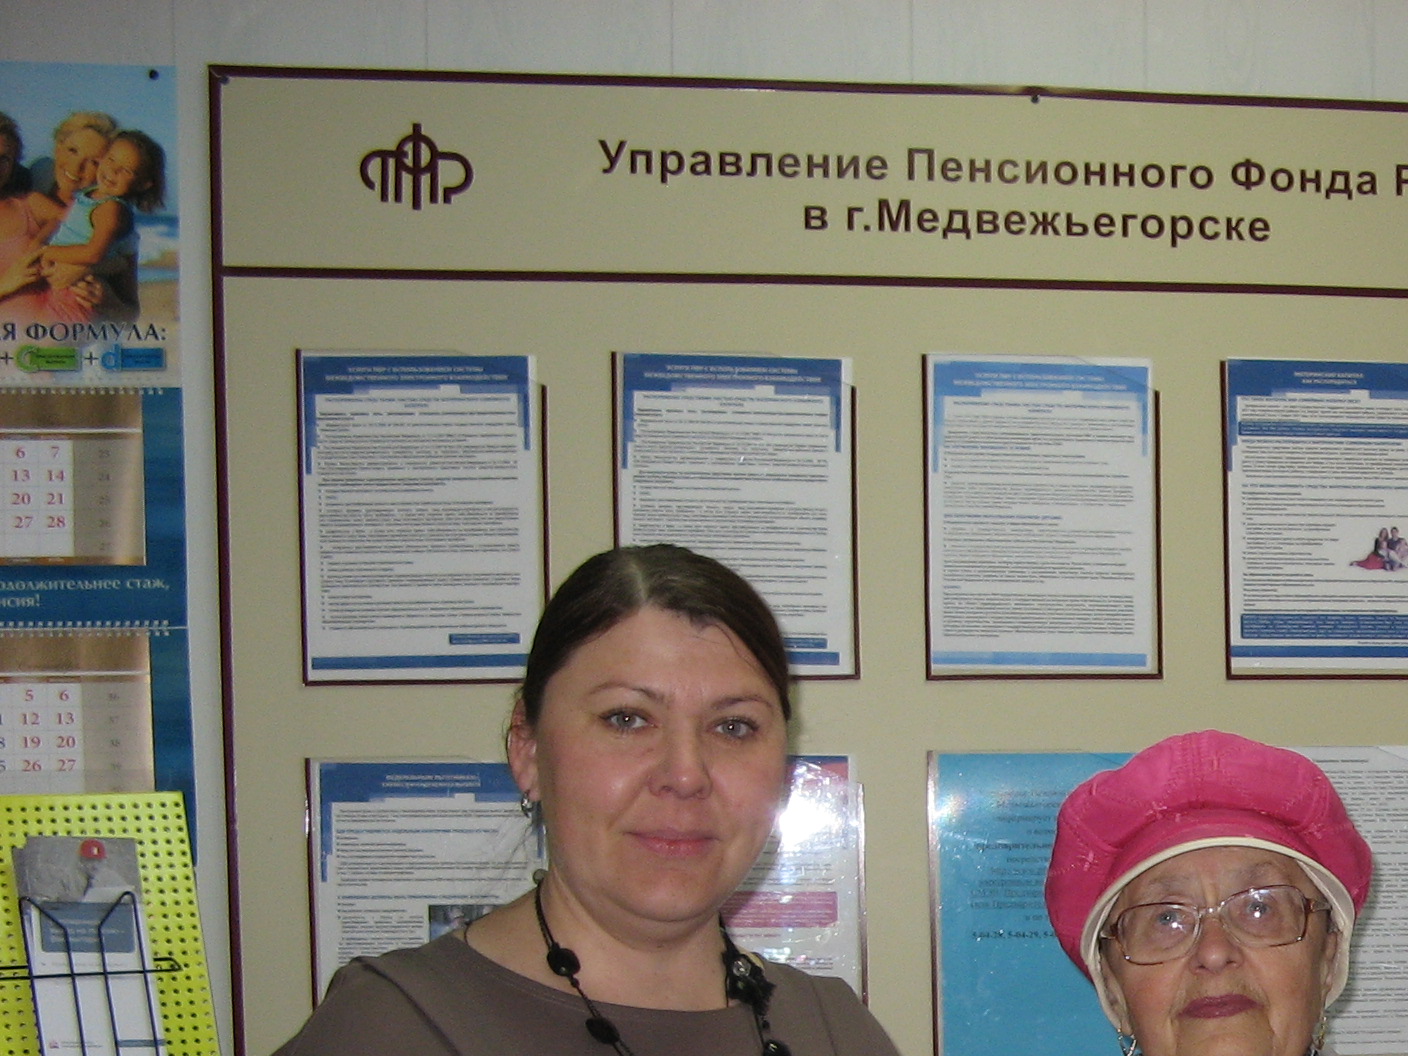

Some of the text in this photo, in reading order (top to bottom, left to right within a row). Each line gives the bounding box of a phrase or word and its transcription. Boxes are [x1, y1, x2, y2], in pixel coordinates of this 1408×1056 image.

[598, 139, 889, 184] Управление
[907, 147, 1214, 191] Пенсионного
[1231, 157, 1378, 199] Фонда
[804, 199, 1271, 247] в г.Медвежьегорске
[0, 323, 167, 341] Я ФОРМУЛА:
[16, 447, 26, 459] 6
[51, 447, 60, 459] 7
[13, 470, 31, 482] 13
[48, 470, 66, 482] 14
[12, 493, 31, 505] 20
[47, 493, 65, 505] 21
[15, 516, 33, 528] 27
[47, 516, 66, 528] 28
[127, 578, 170, 592] стаж,
[25, 690, 35, 701] 5
[59, 690, 69, 701] 6
[22, 713, 41, 725] 12
[56, 713, 75, 725] 13
[22, 737, 41, 748] 19
[56, 736, 76, 748] 20
[22, 760, 42, 772] 26
[58, 759, 77, 772] 27
